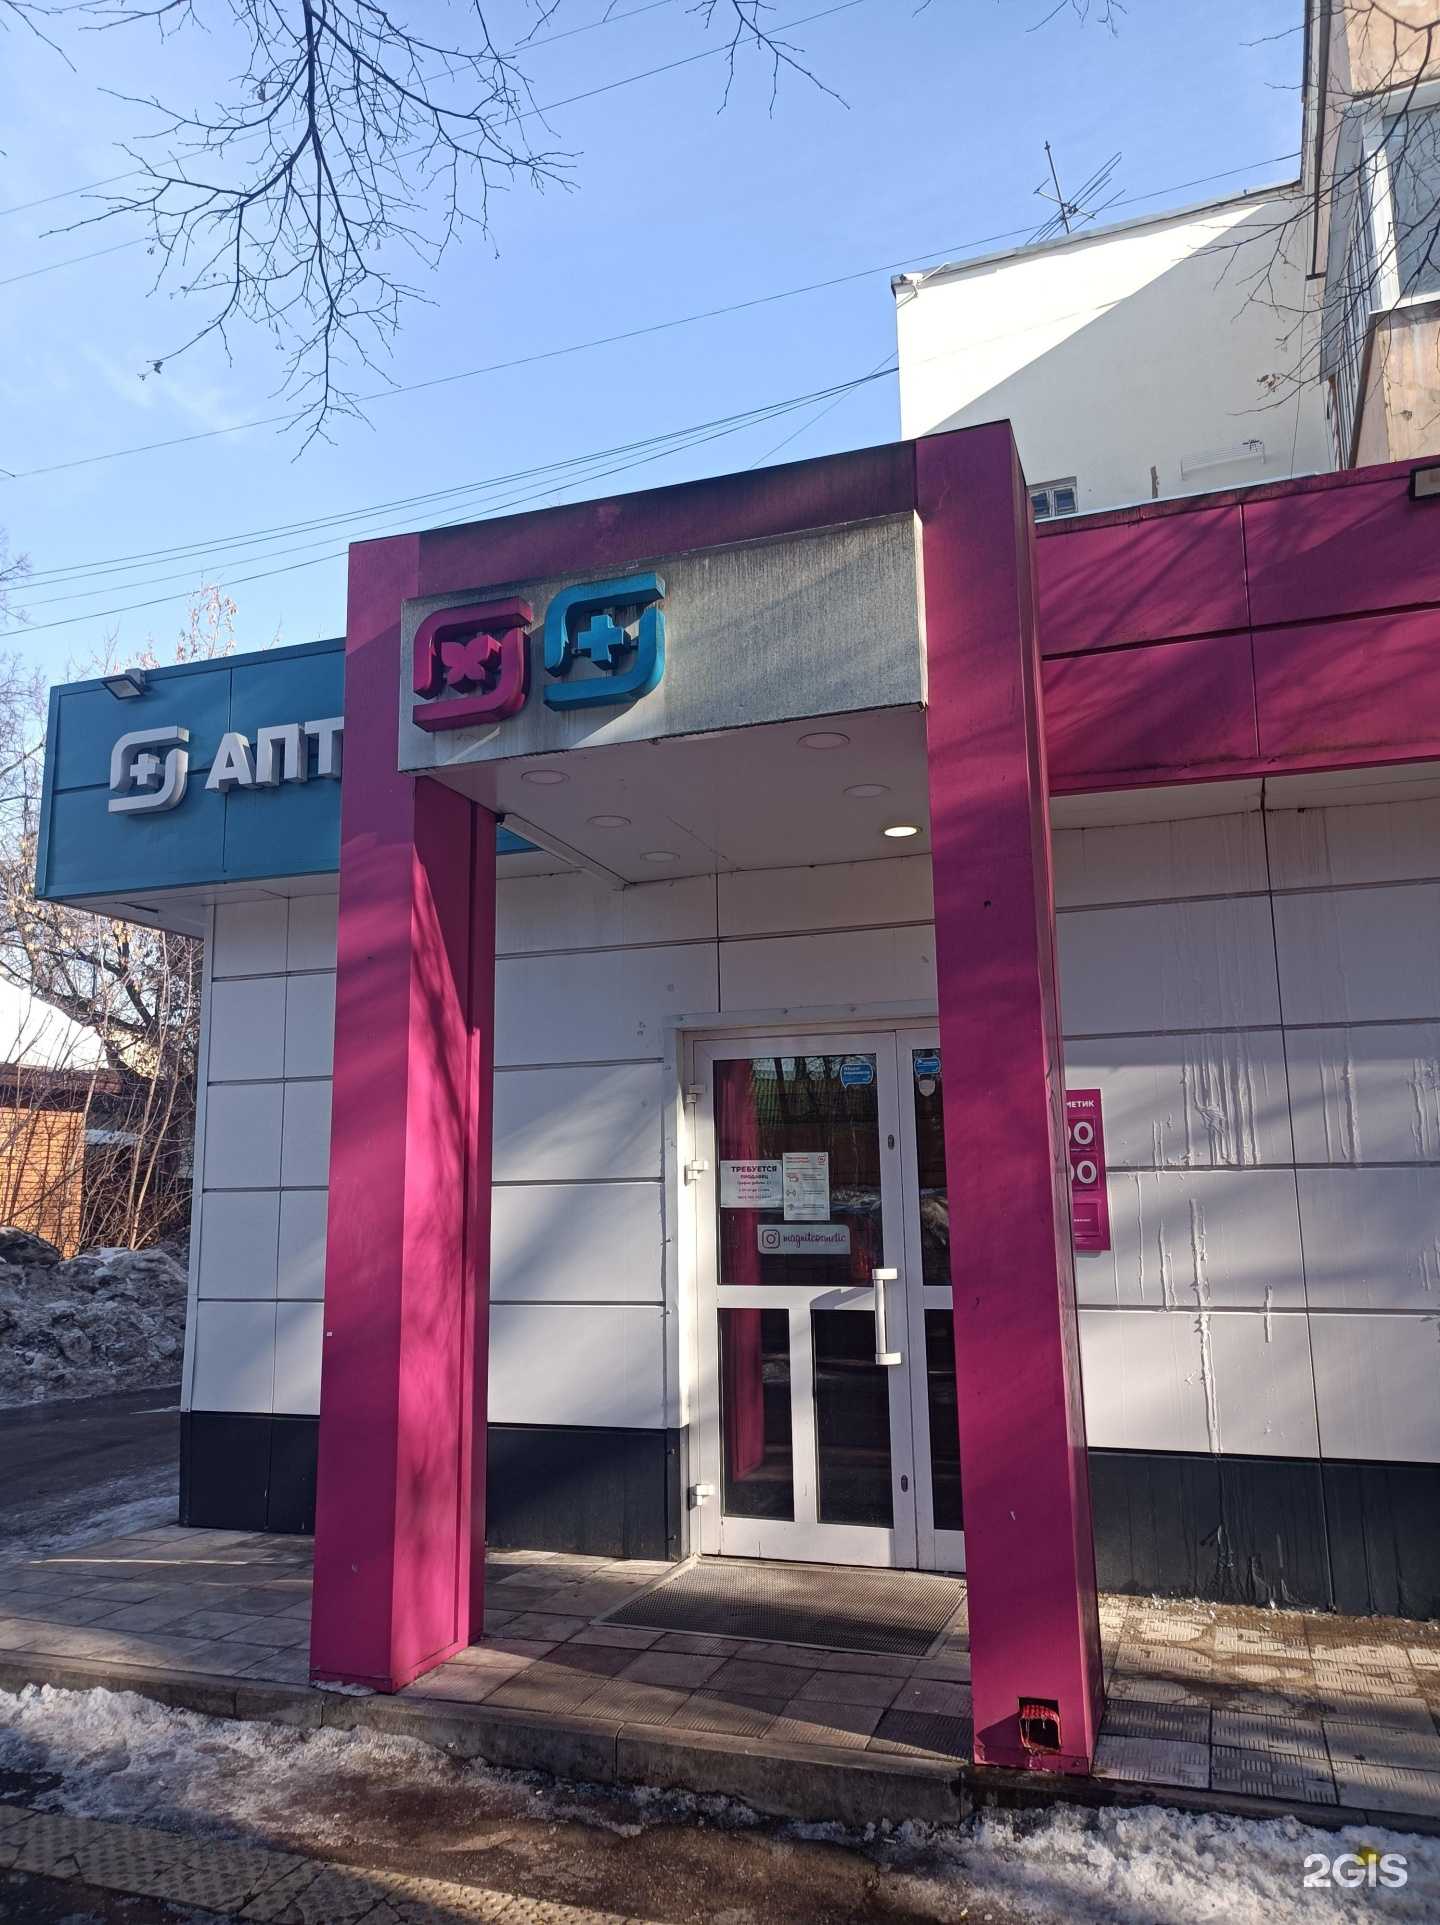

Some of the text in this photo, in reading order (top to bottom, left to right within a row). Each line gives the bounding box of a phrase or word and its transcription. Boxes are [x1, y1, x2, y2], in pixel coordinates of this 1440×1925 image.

[204, 716, 344, 792] АПТ
[731, 1165, 777, 1173] ТРЕБУЕТСЯ
[783, 1232, 847, 1248] magnitcosmetic
